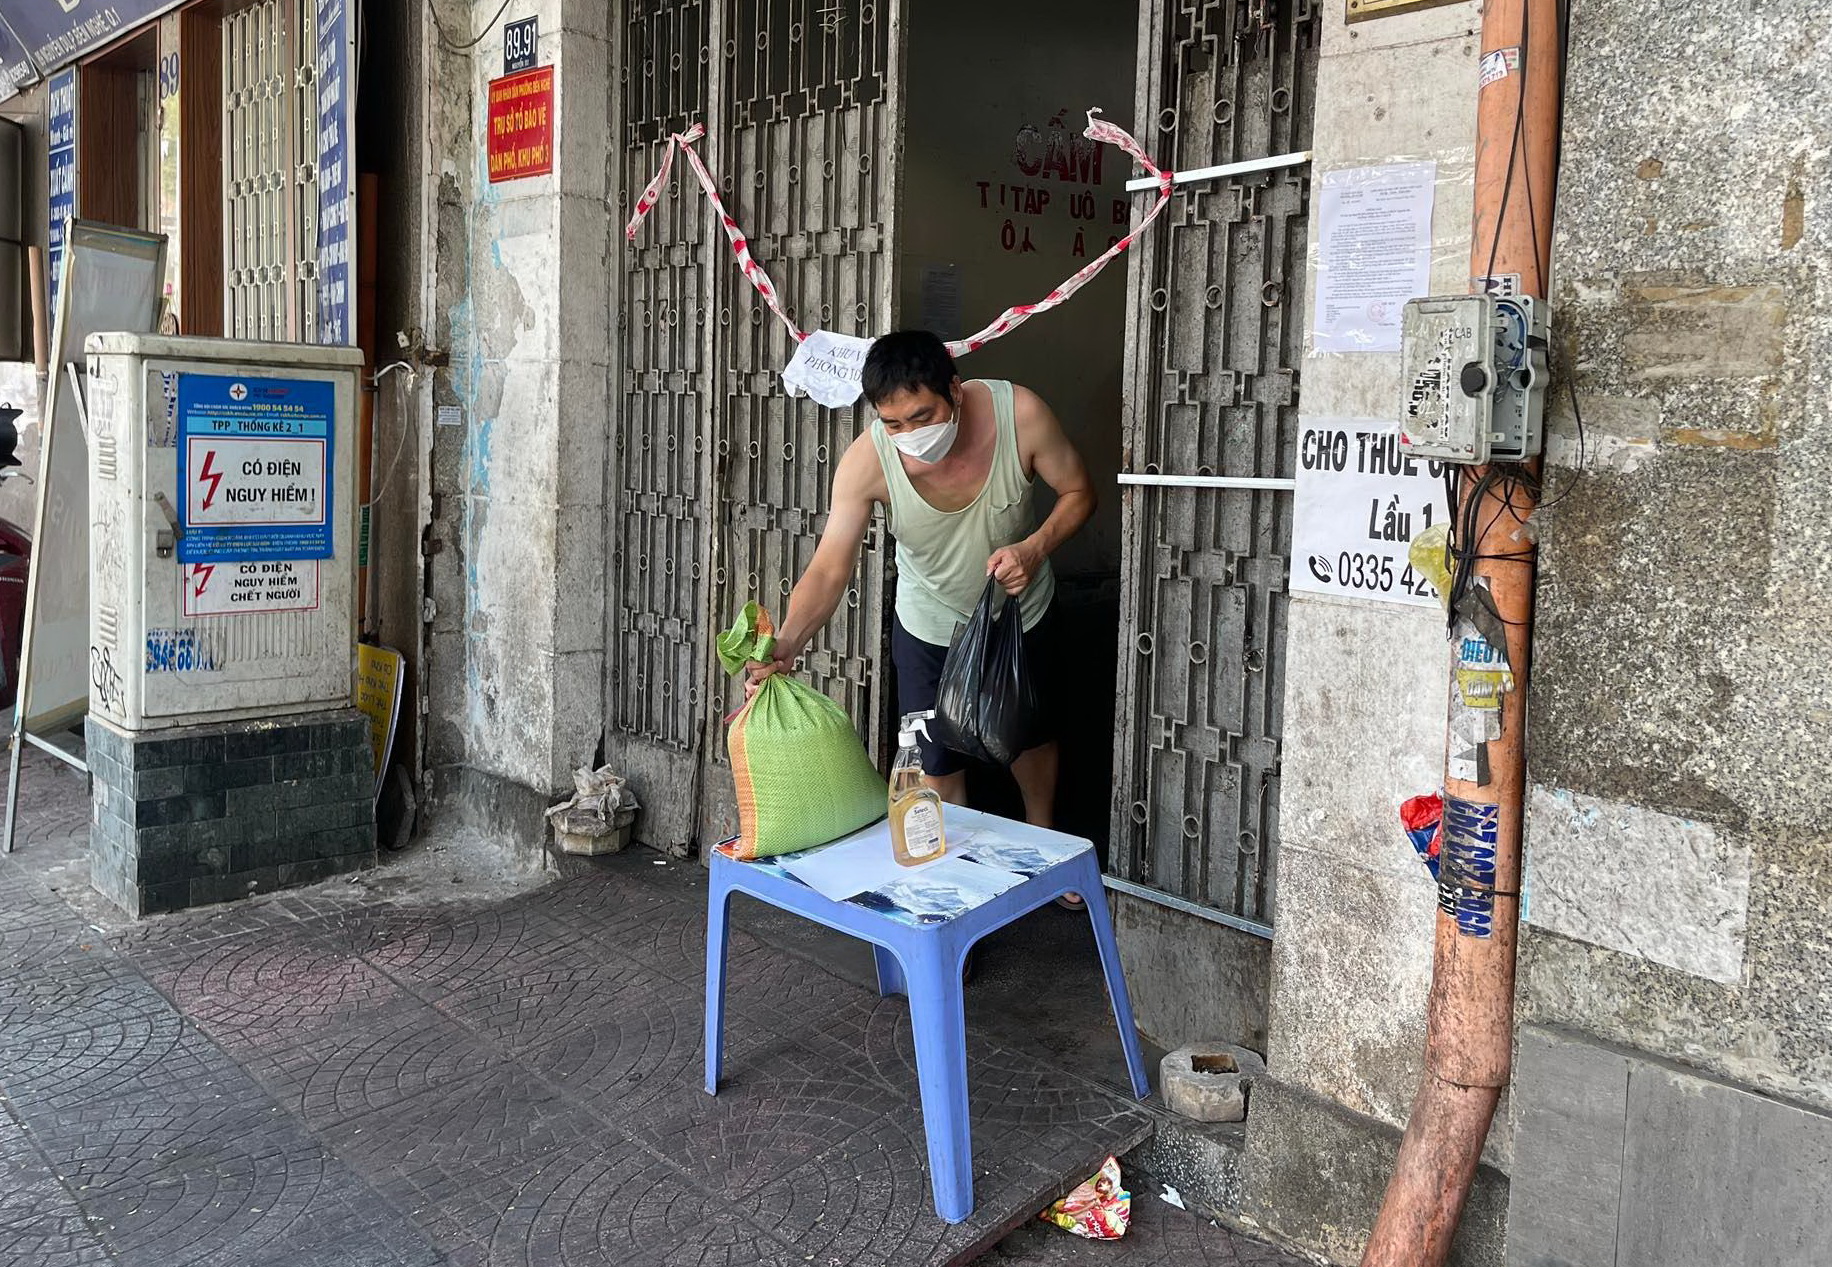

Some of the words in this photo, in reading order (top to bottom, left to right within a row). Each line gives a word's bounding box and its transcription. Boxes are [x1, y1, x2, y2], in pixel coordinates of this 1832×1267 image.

[506, 23, 536, 60] 89.91
[161, 52, 179, 99] 89
[494, 115, 505, 139] TRỤ
[506, 106, 515, 134] SỞ
[515, 101, 524, 131] TỔ
[524, 101, 537, 130] BẢO
[537, 101, 547, 133] VỆ
[491, 149, 503, 173] DÂN
[518, 146, 531, 168] KHU
[532, 136, 544, 166] PHỐ
[827, 346, 856, 360] KHU
[252, 403, 271, 412] 1900
[272, 404, 282, 412] 54
[272, 420, 284, 433] KÊ
[1301, 429, 1348, 472] CHO
[242, 458, 262, 476] CÓ
[267, 459, 301, 478] ĐIỆN
[226, 488, 267, 502] NGUY
[1369, 494, 1411, 543] Lầu
[240, 562, 257, 574] CÓ
[1338, 551, 1394, 592] 0335
[234, 577, 264, 588] NGUY
[268, 573, 298, 586] HIỂM
[230, 589, 261, 602] CHẾT
[266, 588, 301, 600] NGƯỜI
